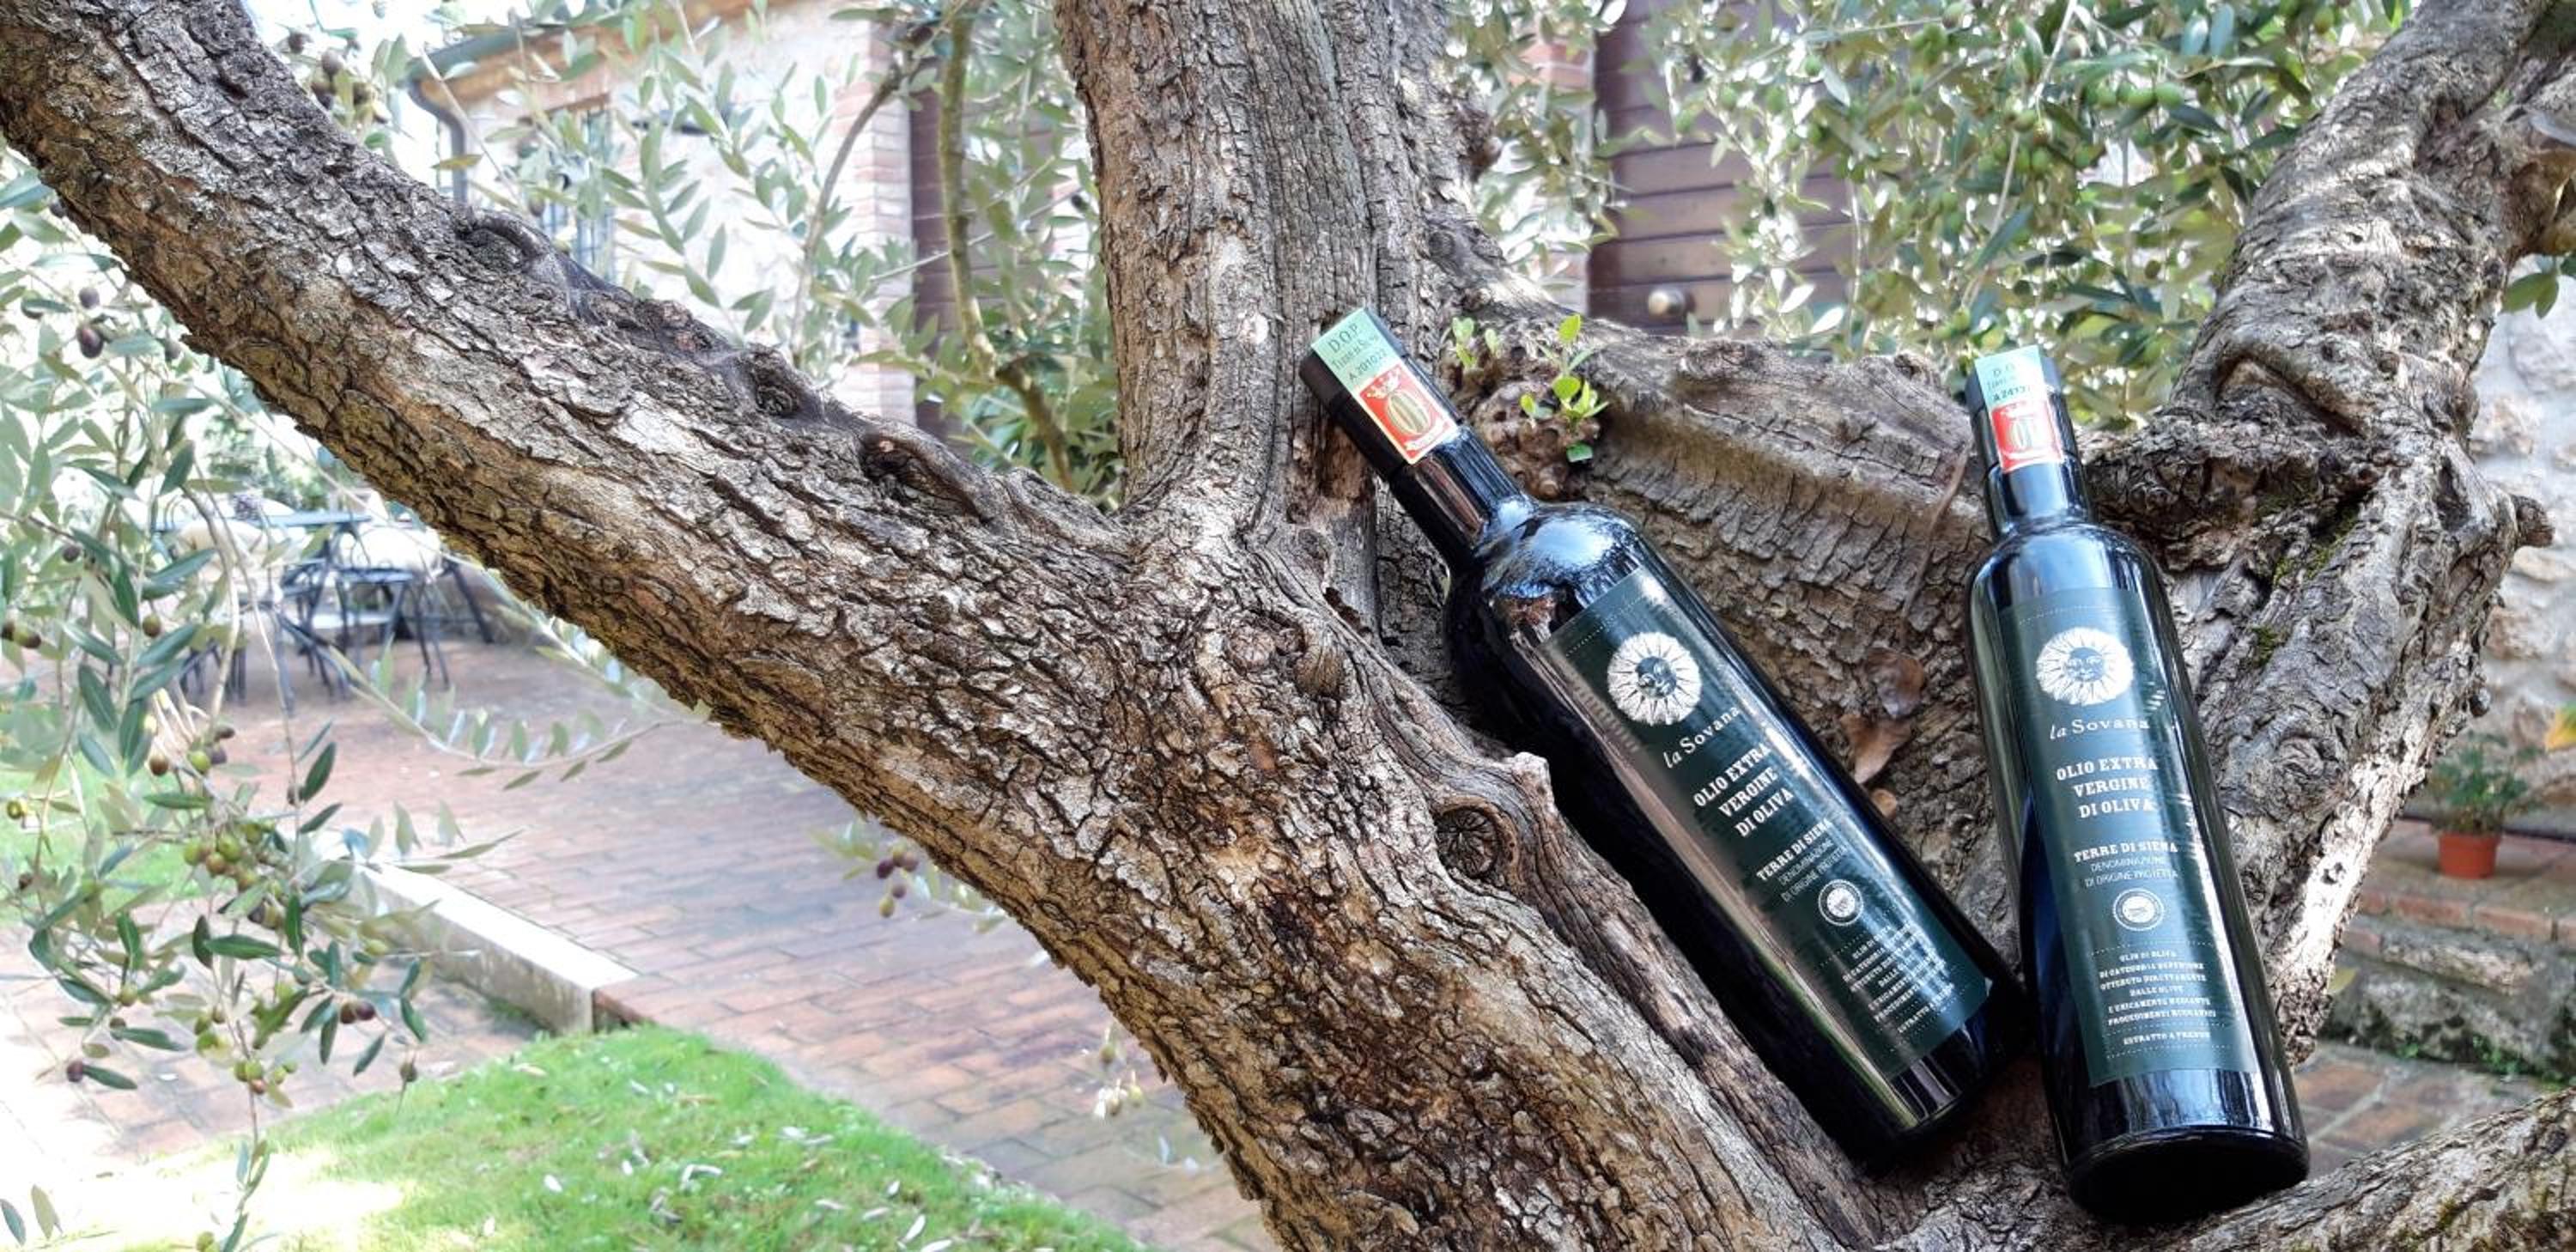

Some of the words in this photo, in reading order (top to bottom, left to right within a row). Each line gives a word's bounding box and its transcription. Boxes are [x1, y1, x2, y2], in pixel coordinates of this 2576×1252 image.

[1662, 751, 1682, 769] la
[1679, 707, 1741, 754] Sovana
[2050, 725, 2067, 739] la
[2071, 718, 2150, 734] Sovana
[1693, 776, 1728, 806] OLIO
[1725, 743, 1771, 782] EXTRA
[2057, 761, 2094, 781] OLIO
[2099, 757, 2159, 771] EXTRA
[2074, 776, 2153, 798] VERGINE
[1735, 817, 1757, 837] DI
[1753, 787, 1794, 823] OLIVA
[2079, 803, 2098, 818] DI
[2101, 798, 2156, 813] OLIVA
[1756, 849, 1795, 881] TERRE
[1790, 840, 1807, 855] DI
[2074, 844, 2117, 862] TERRE
[2120, 842, 2136, 853] DI
